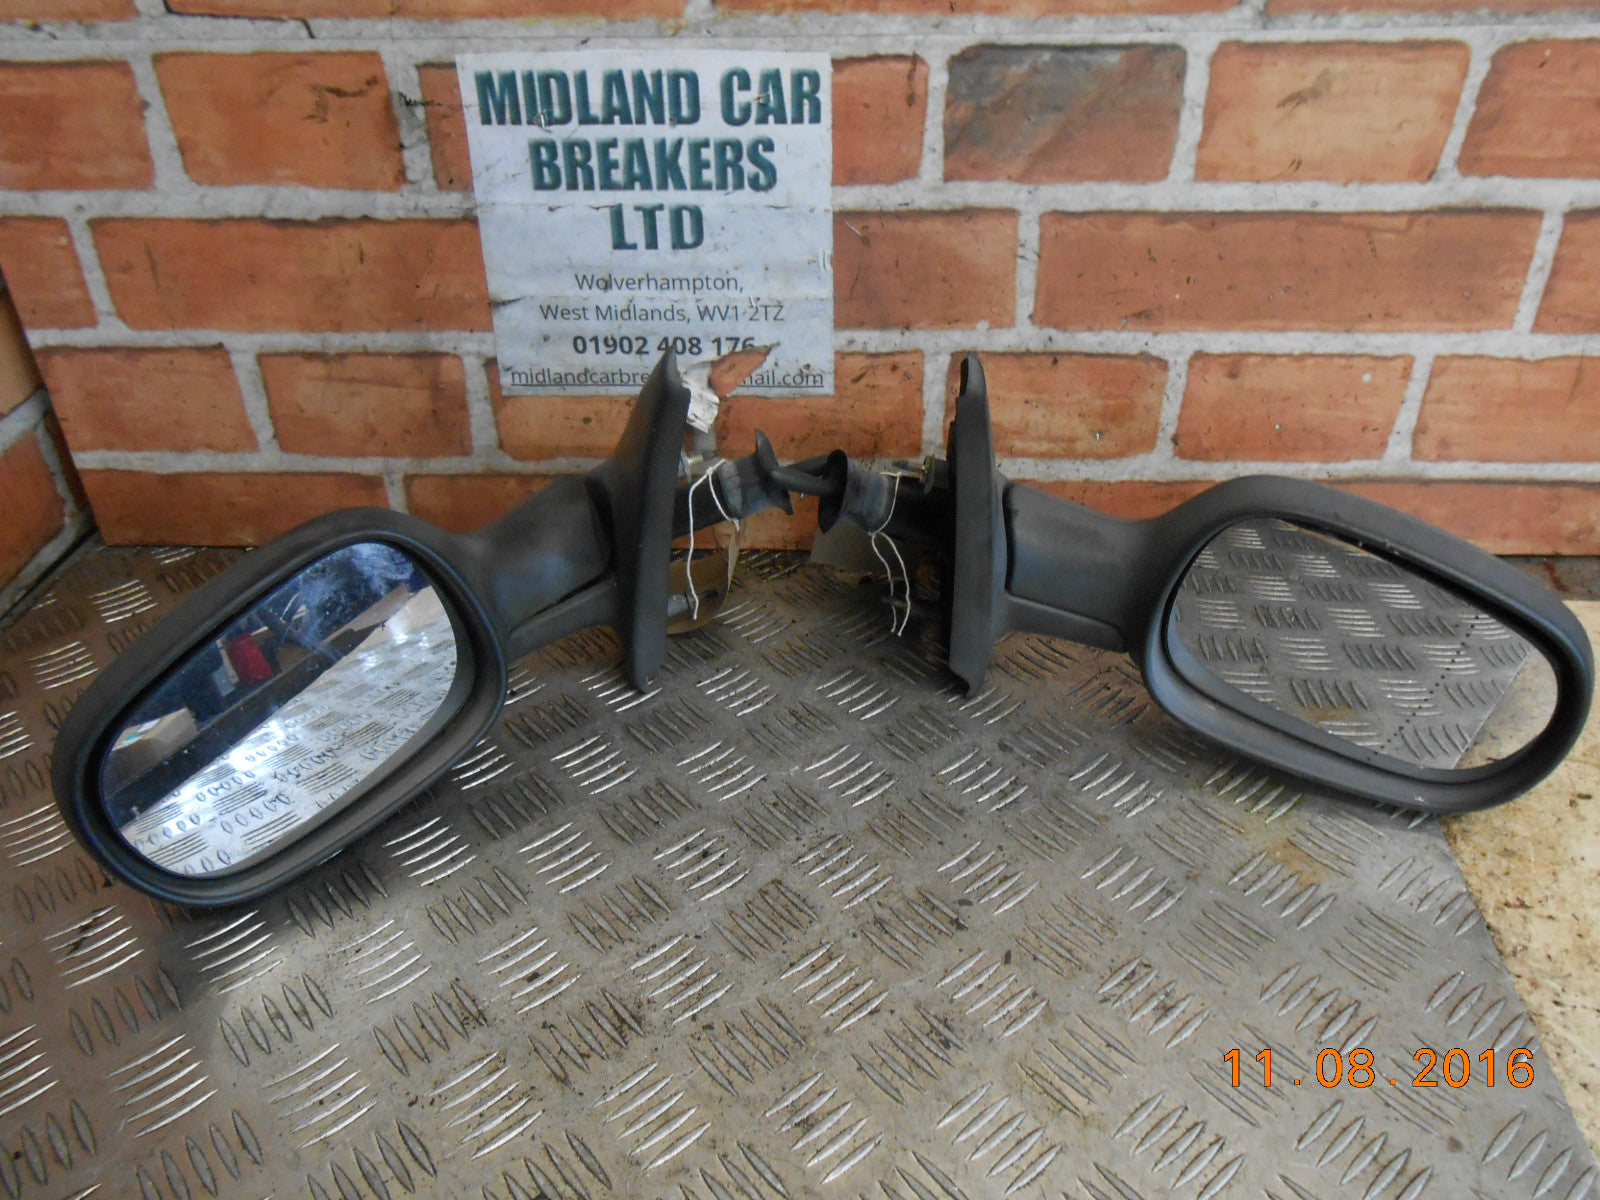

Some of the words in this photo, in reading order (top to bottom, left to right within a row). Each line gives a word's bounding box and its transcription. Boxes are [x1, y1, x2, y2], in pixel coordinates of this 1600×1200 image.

[474, 69, 701, 126] MIDLAND
[720, 67, 822, 127] CAR
[528, 136, 778, 192] BREAKERS
[608, 202, 705, 250] LTD
[574, 273, 744, 294] Wolverhampton,
[540, 304, 589, 321] West
[596, 304, 691, 324] Midlands,
[697, 305, 740, 322] WV1
[748, 304, 785, 322] 2TZ
[572, 335, 650, 355] 01902
[656, 336, 702, 355] 408
